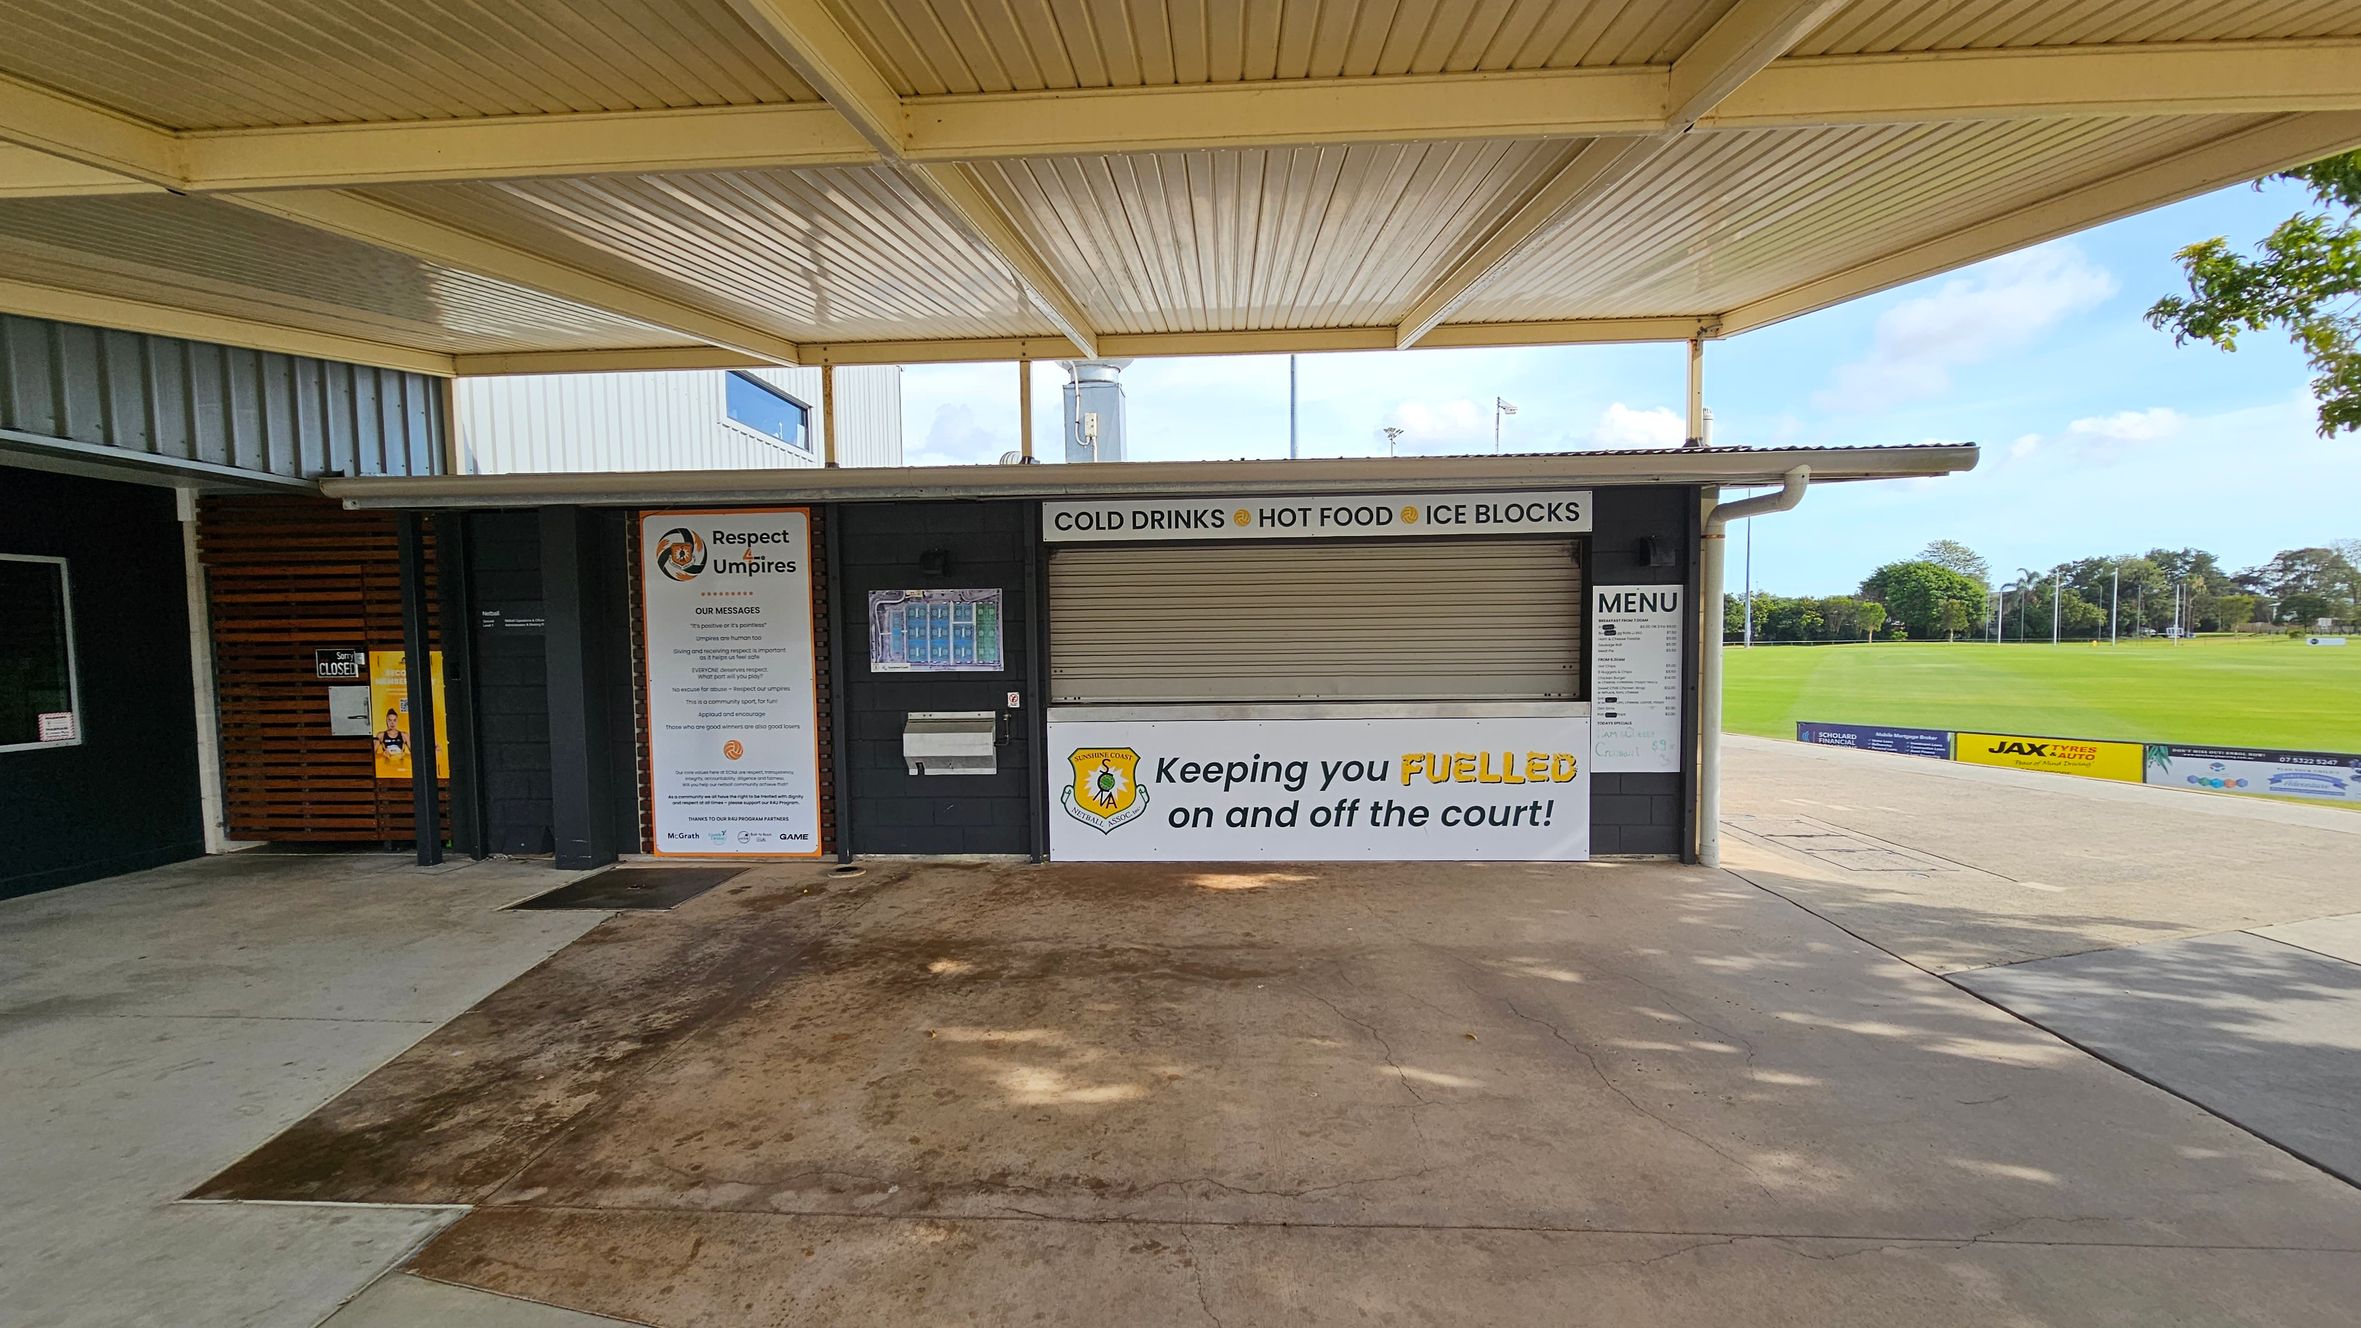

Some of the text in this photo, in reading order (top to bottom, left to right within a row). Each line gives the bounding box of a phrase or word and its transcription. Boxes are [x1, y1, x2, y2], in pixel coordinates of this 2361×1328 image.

[1055, 501, 1580, 531] COLD DRINKS HOT FOOD ICE BLOCKS
[713, 530, 790, 547] Respect
[714, 556, 796, 577] Umpires
[1598, 592, 1678, 613] MENU
[695, 607, 760, 615] OUR MESSAGES
[336, 652, 354, 662] Sorry
[320, 662, 357, 676] CLOSED
[1818, 732, 1857, 740] SCHOLARD
[1988, 741, 2051, 757] JAX
[2052, 744, 2097, 754] TYRES
[2058, 752, 2096, 760] AUTO
[1074, 752, 1133, 762] SUNSHINE COAST
[2316, 758, 2338, 766] 5247
[1155, 751, 1578, 792] Keeping you FUELLED
[1071, 807, 1104, 827] NETBALL
[1168, 798, 1554, 828] on and off the court!
